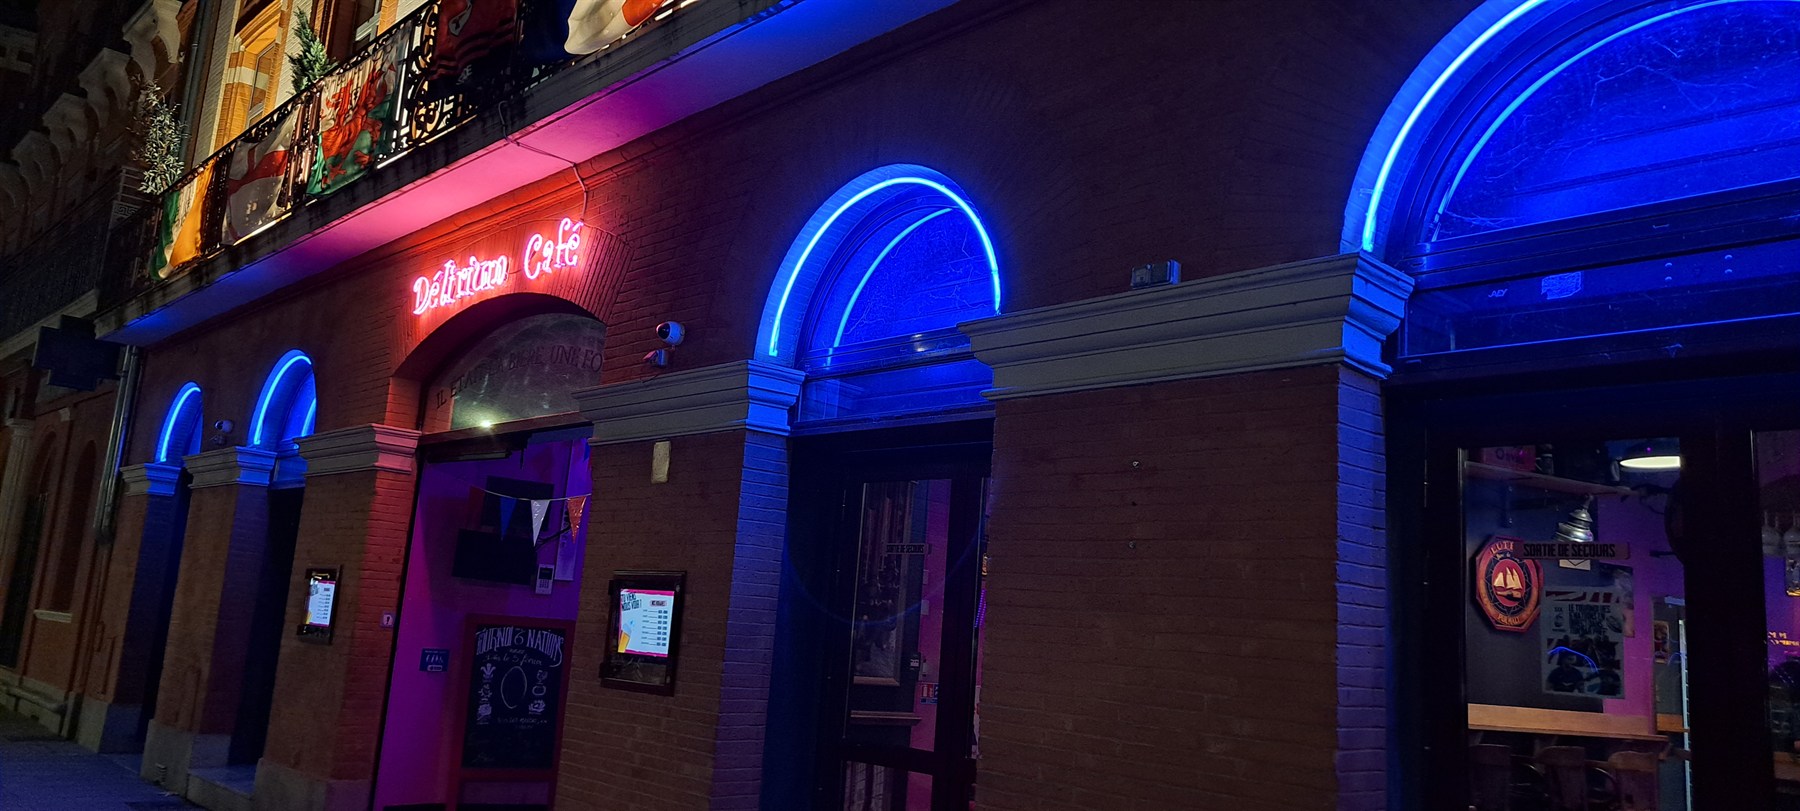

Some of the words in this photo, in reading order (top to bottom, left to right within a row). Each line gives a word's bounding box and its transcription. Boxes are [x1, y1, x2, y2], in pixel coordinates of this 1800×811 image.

[413, 255, 509, 315] Délirium
[523, 217, 585, 280] Café
[435, 389, 448, 410] IL
[550, 345, 581, 368] UNE
[1522, 543, 1557, 558] SORTIE
[1557, 543, 1571, 558] DE
[1571, 543, 1617, 559] SECOURS
[526, 629, 565, 668] NATIONS
